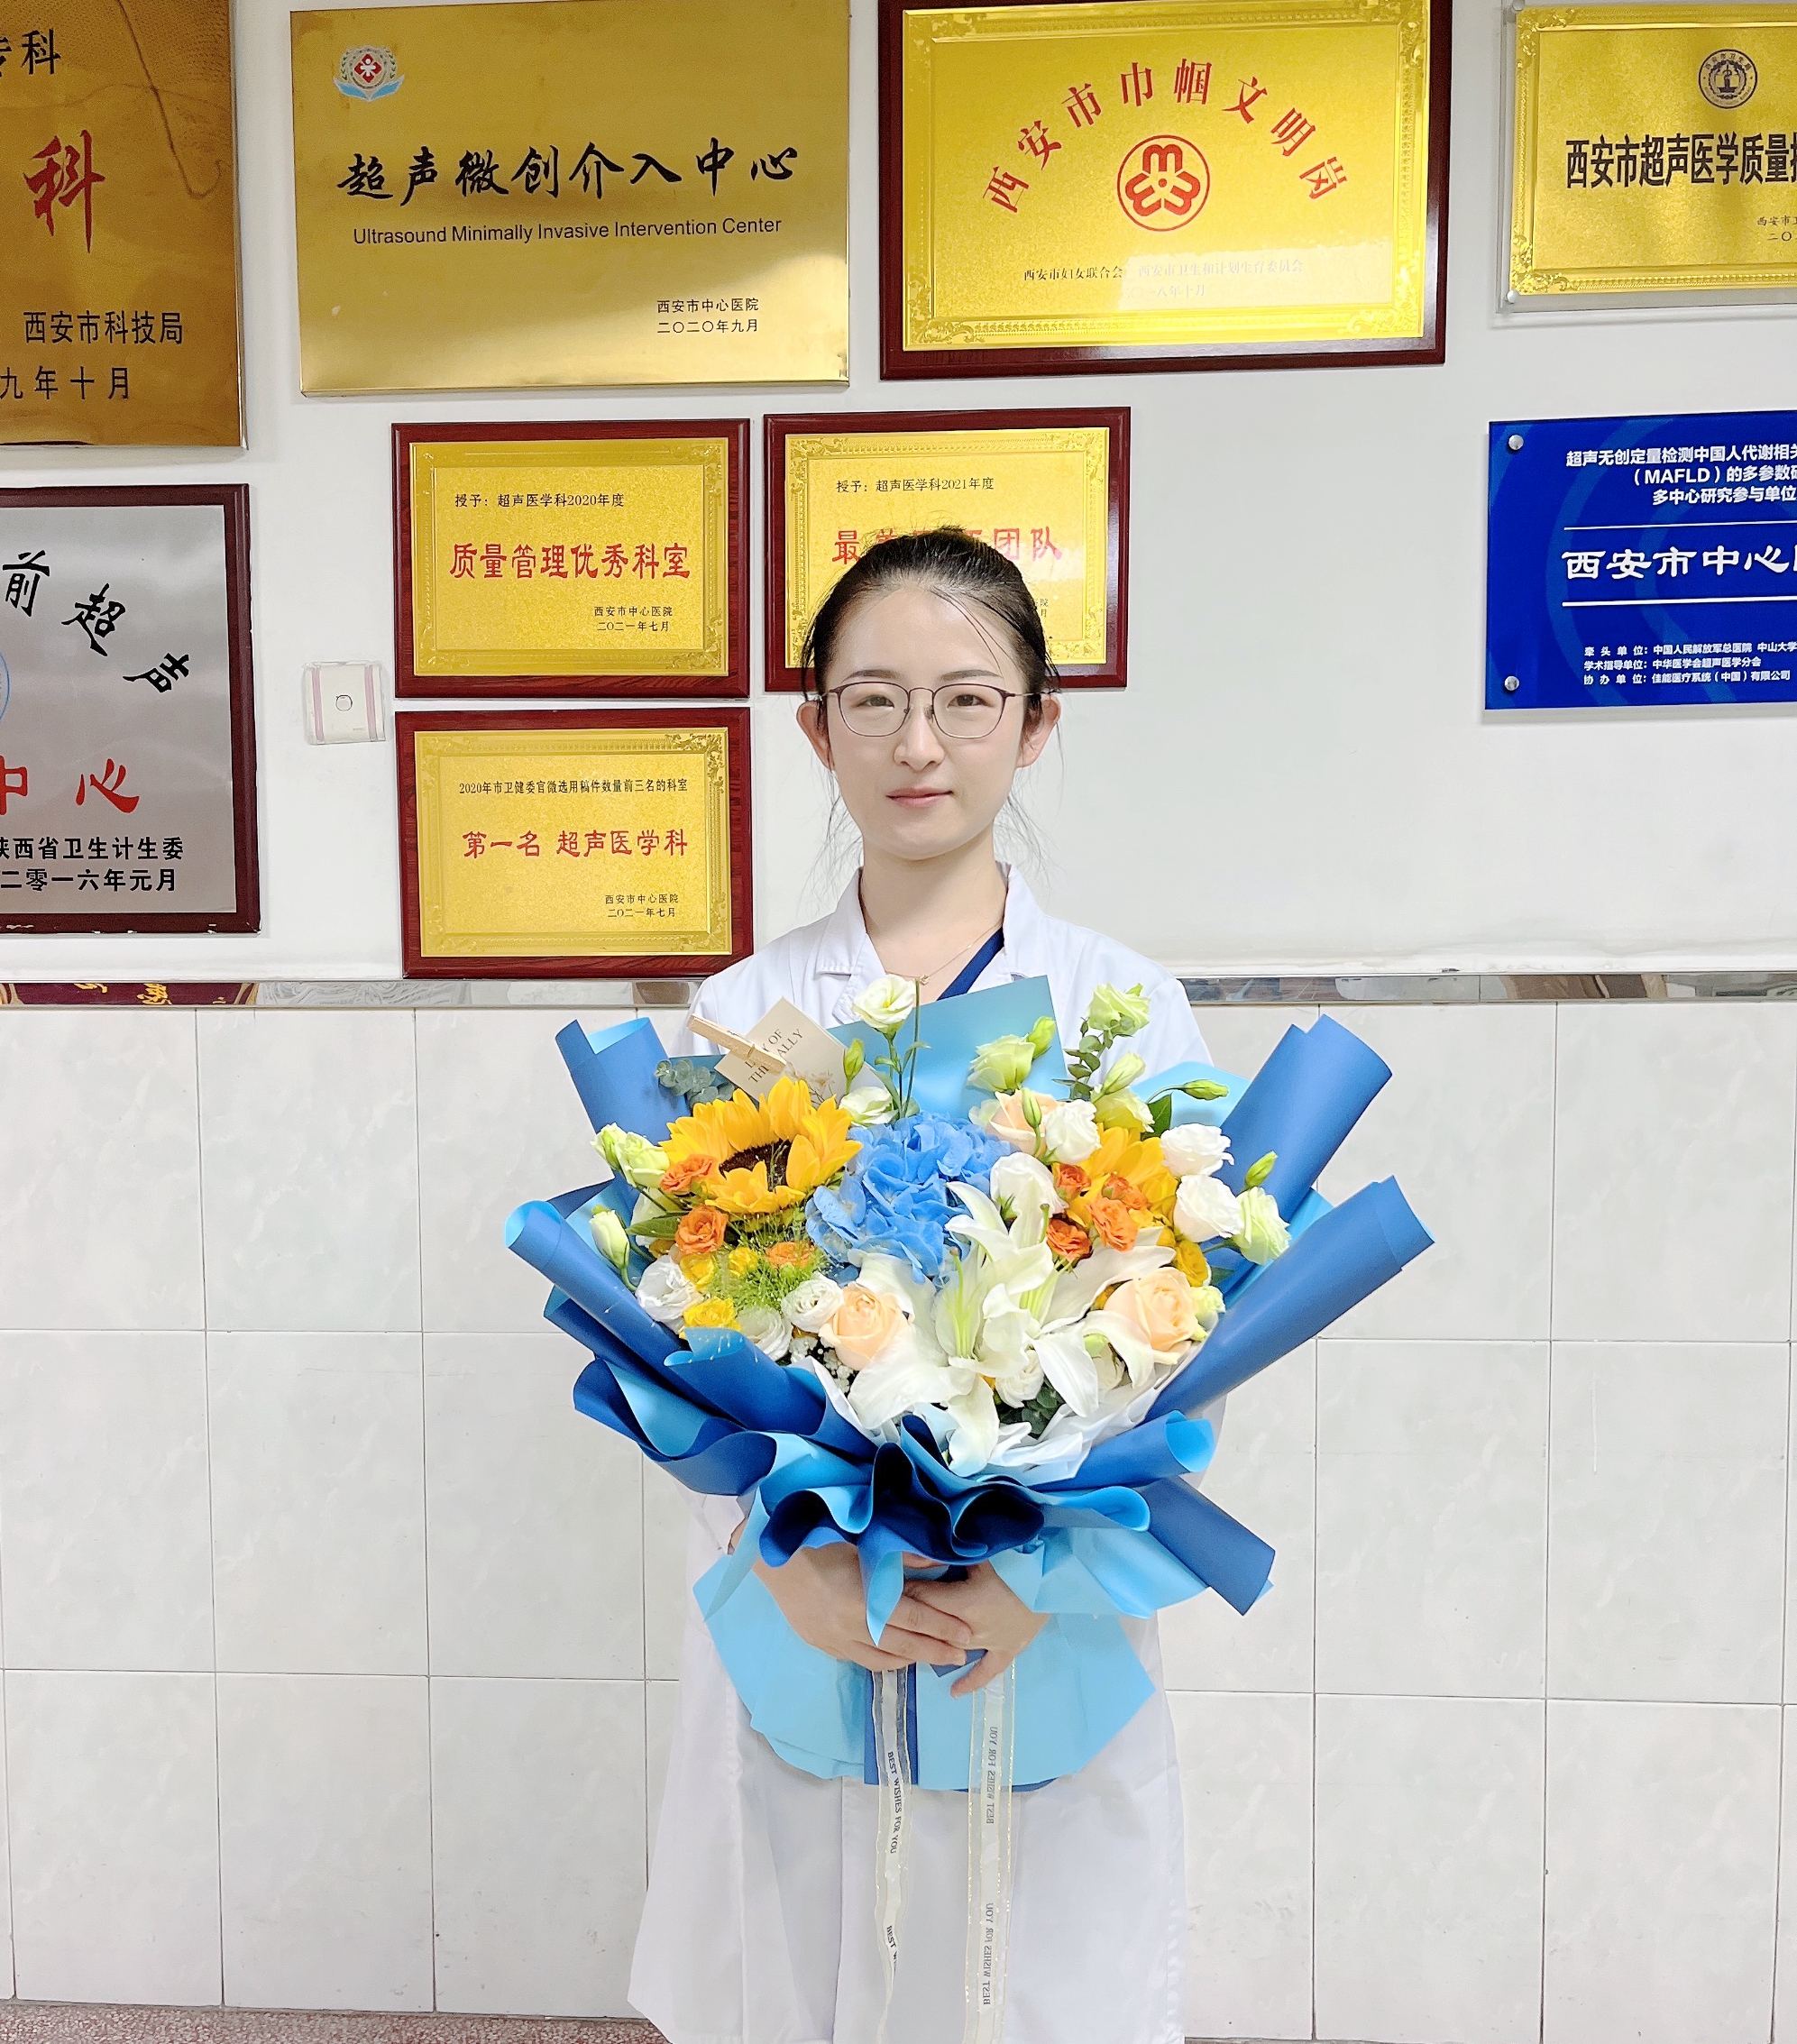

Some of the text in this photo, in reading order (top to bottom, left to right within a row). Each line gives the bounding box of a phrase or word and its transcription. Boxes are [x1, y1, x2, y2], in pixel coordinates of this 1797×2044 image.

[981, 59, 1350, 214] 西安市巾帼文明岗
[337, 137, 798, 206] 超声微创介入中心
[23, 129, 105, 253] 科
[353, 216, 783, 244] Ultrasound Minimally Invasive Intervention Center
[1024, 265, 1123, 281] 西安市妇女联合会
[657, 298, 759, 314] 西安市中心医院
[23, 310, 183, 344] 西安市科技局
[0, 365, 130, 399] 九年十月
[1653, 485, 1797, 506] 多中心研究参与单位
[449, 542, 691, 580] 质量管理优秀科室
[831, 526, 1063, 565] 最团队
[1562, 545, 1797, 580] 西安市中心
[593, 606, 674, 618] 西安市中心医院
[462, 829, 688, 859] 第一名 超声医学科
[1, 867, 176, 893] 二零一六年元月
[605, 893, 679, 905] 西安市中心医院
[768, 1028, 783, 1045] OF
[887, 1751, 903, 1854] BEST WISHES FOR YOU
